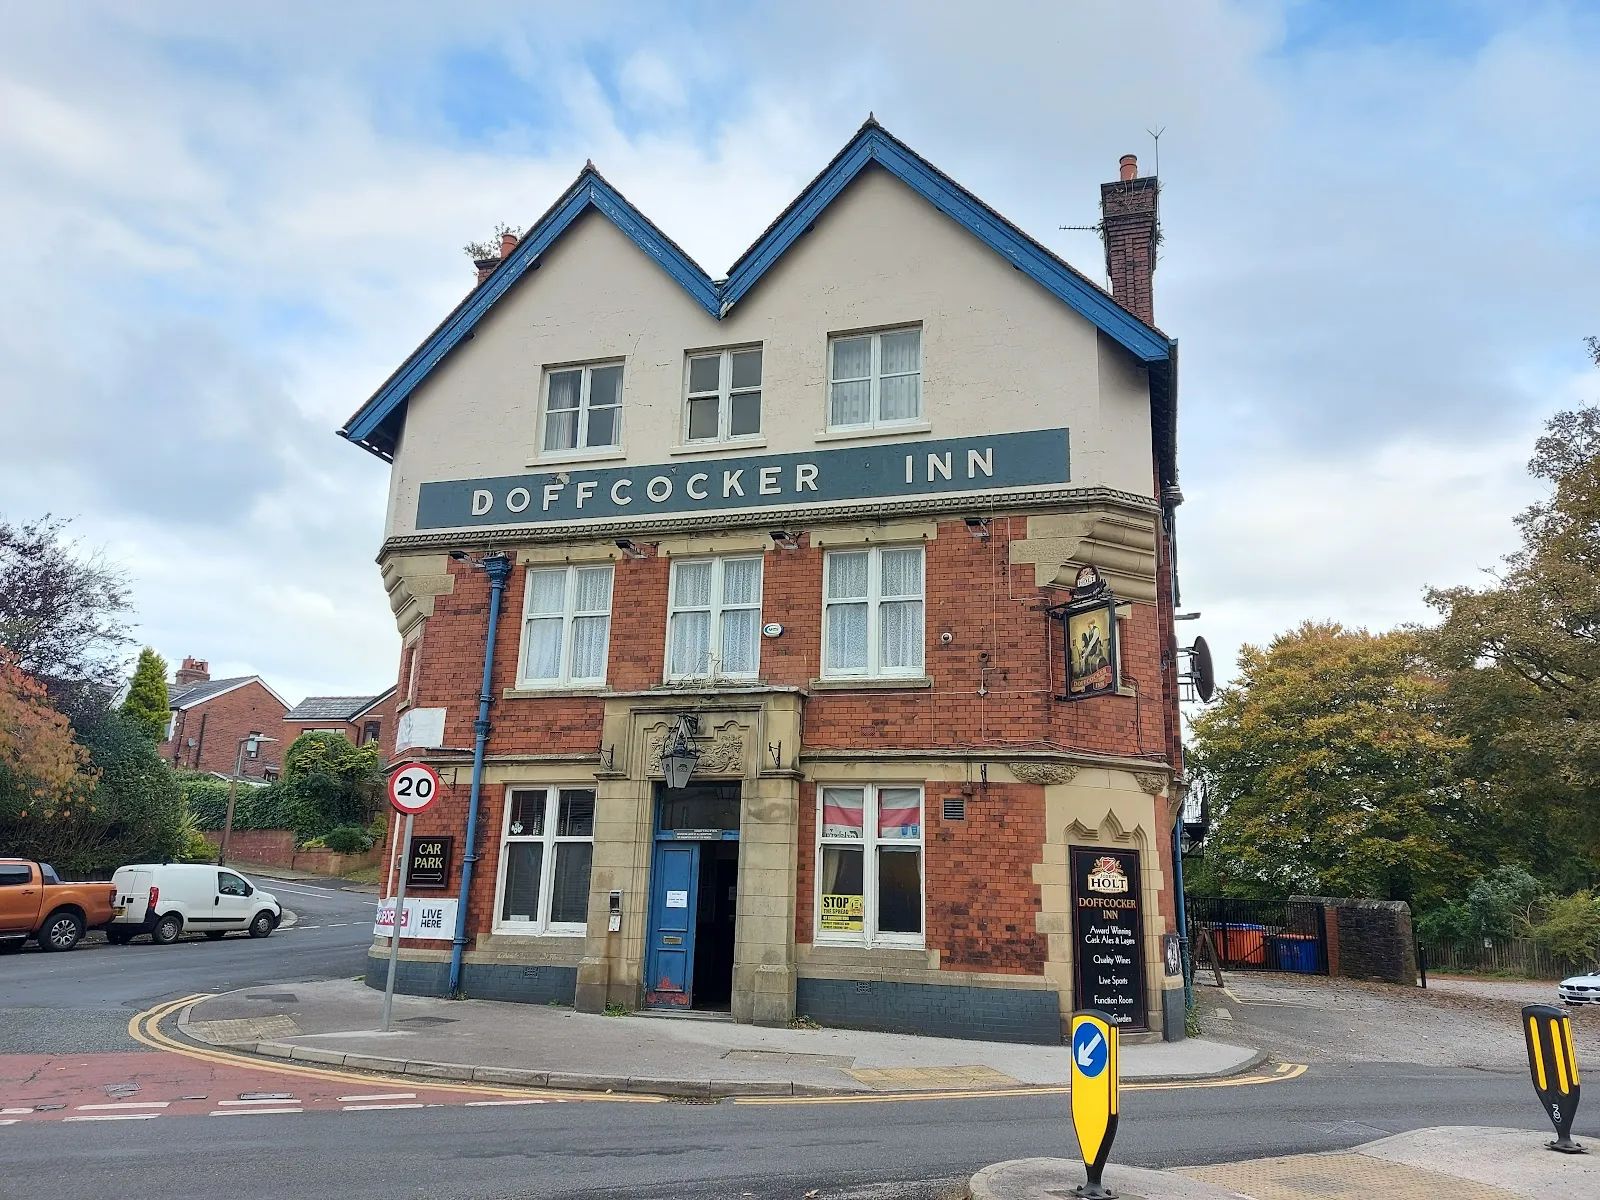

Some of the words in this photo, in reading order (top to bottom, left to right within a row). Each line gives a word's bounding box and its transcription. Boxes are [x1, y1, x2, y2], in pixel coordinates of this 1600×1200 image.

[470, 463, 819, 516] DOFFCOCKER
[905, 447, 994, 484] INN
[1073, 667, 1107, 687] DOFFCOCKER
[1095, 681, 1105, 689] INN
[397, 776, 432, 798] 20
[419, 843, 441, 855] CAR
[414, 857, 443, 869] PARK
[1091, 879, 1126, 888] HOLT
[823, 896, 849, 908] STOP
[1078, 898, 1137, 909] DOFFCOCKER
[421, 909, 442, 919] LIVE
[1102, 909, 1119, 920] INN
[420, 919, 442, 928] HERE
[1090, 925, 1110, 935] Award
[1110, 925, 1131, 936] Winning
[1085, 934, 1100, 944] Cask
[1101, 935, 1114, 945] Ales
[1114, 936, 1120, 945] &
[1120, 935, 1136, 946] Lagers
[1093, 954, 1114, 965] Quality
[1114, 955, 1131, 964] Wines
[1098, 975, 1111, 985] Live
[1111, 975, 1129, 986] Sports
[1093, 994, 1118, 1005] Function
[1118, 994, 1134, 1005] Room
[1112, 1013, 1132, 1023] Garden
